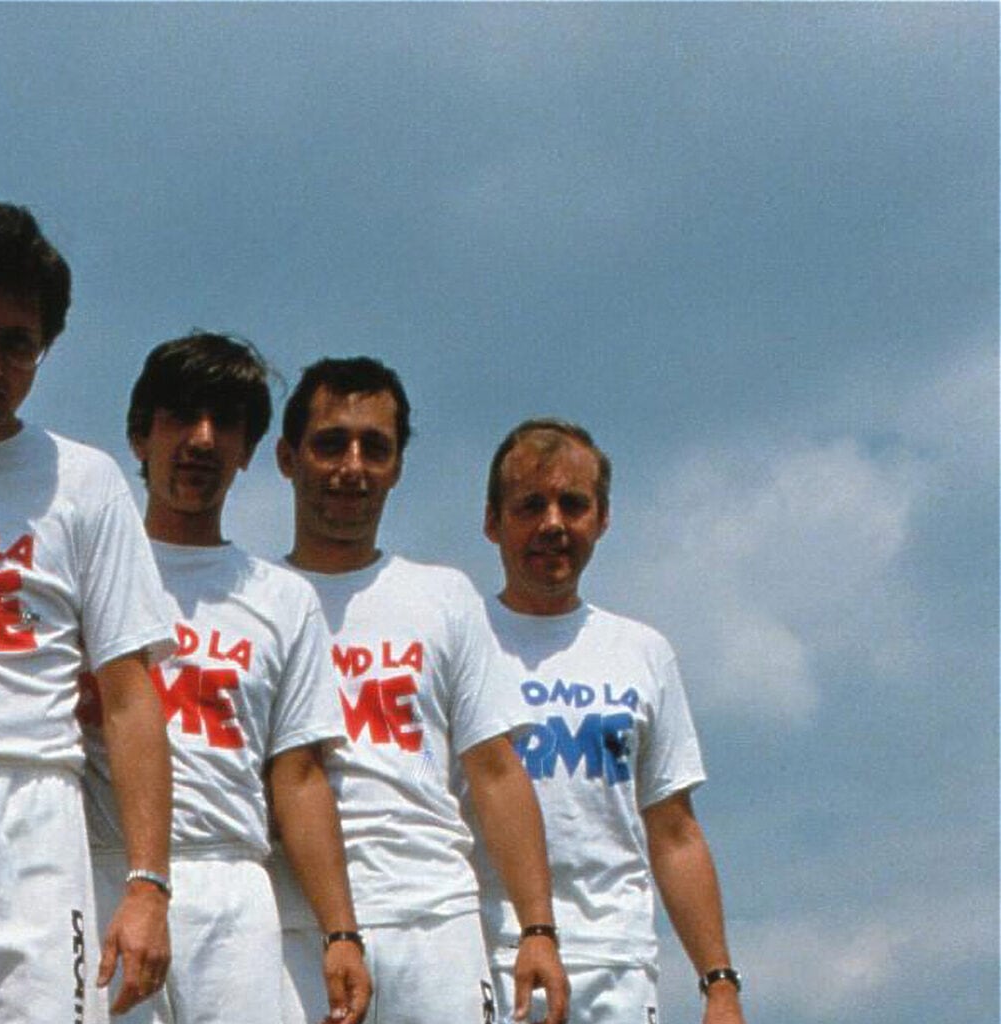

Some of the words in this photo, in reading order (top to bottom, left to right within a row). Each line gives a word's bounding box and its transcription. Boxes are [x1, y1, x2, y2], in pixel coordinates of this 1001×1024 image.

[208, 629, 253, 673] LA
[382, 641, 424, 673] LA
[603, 682, 640, 712] LA
